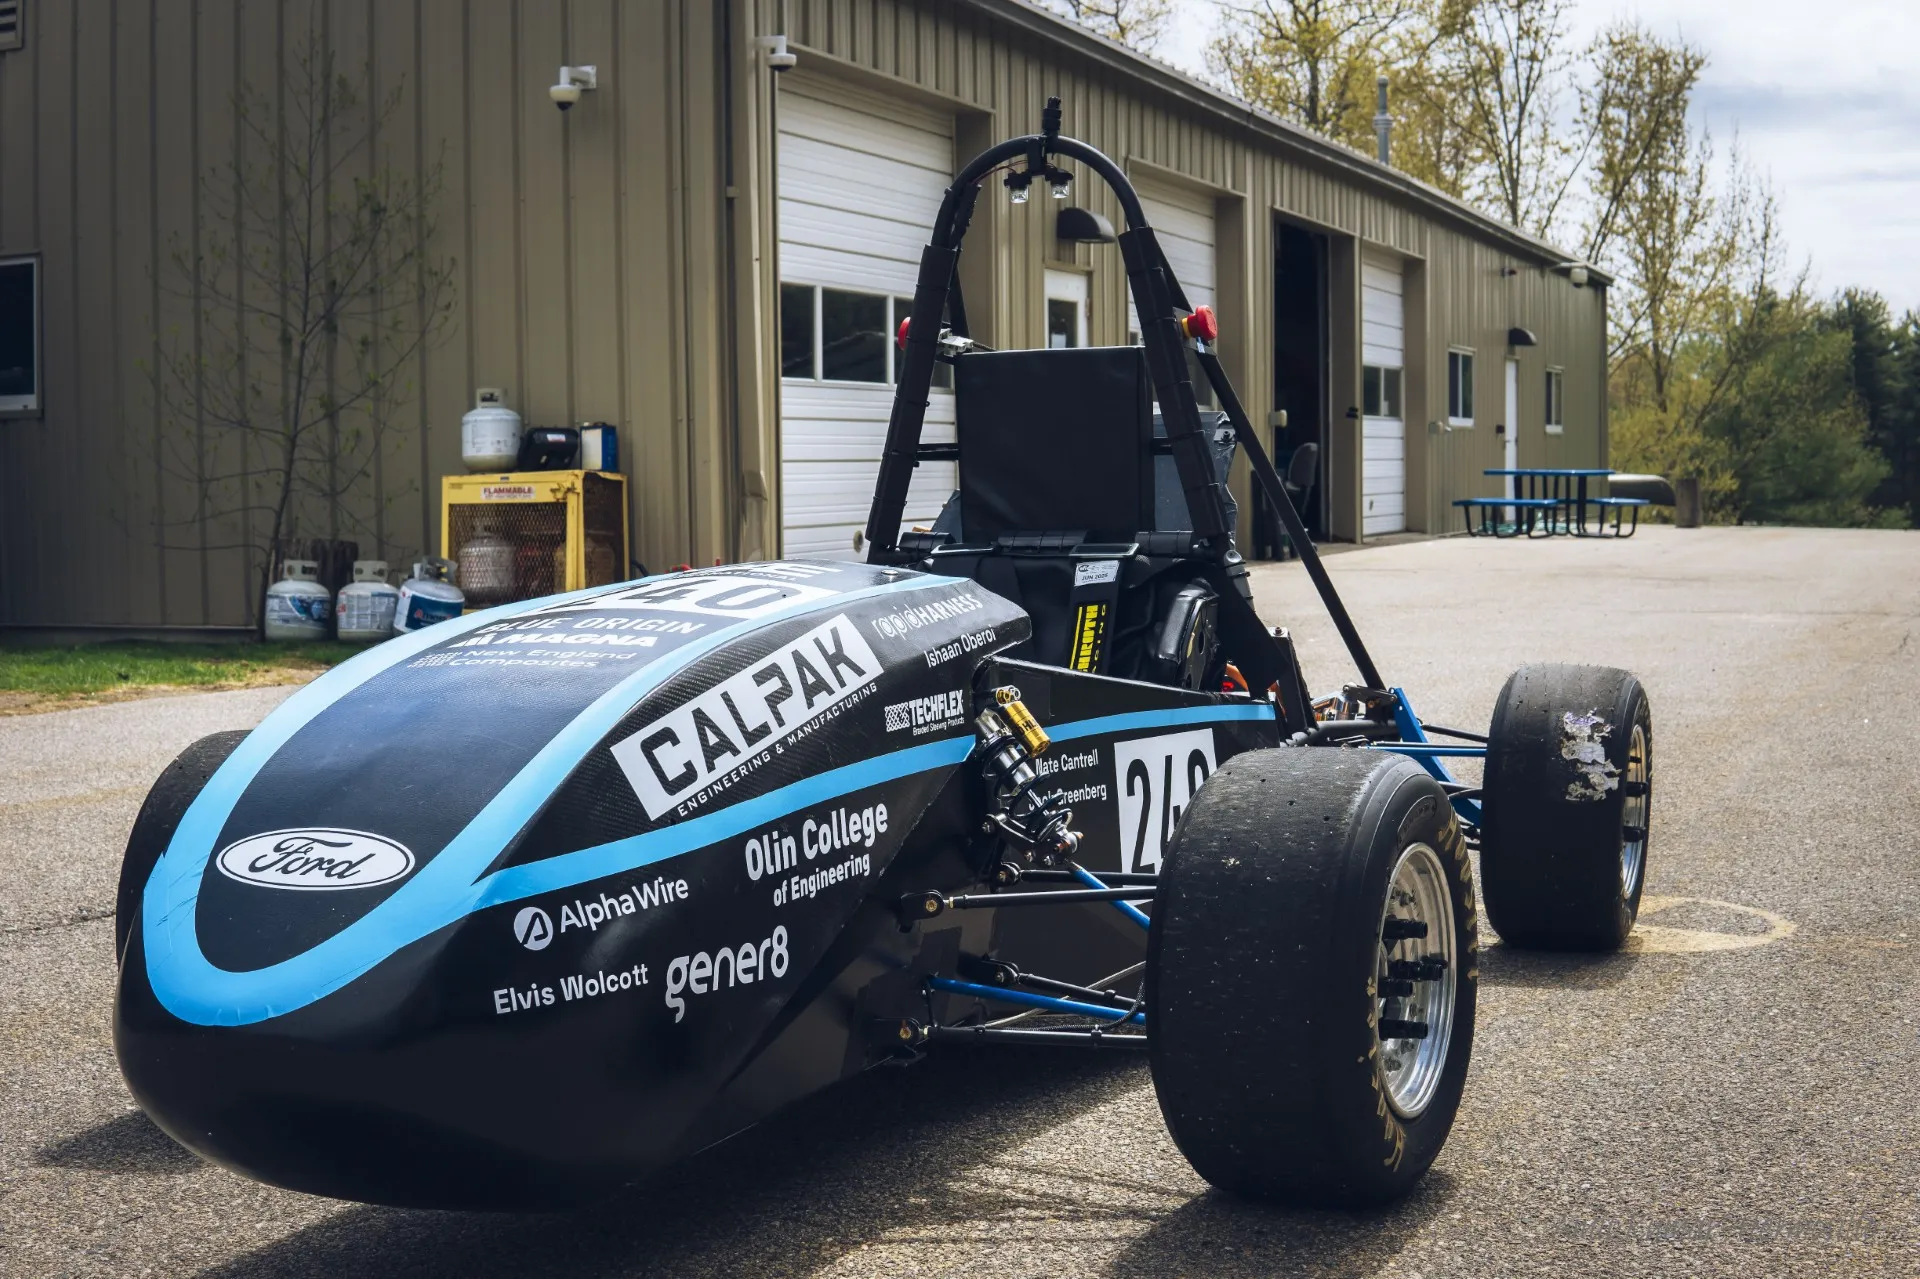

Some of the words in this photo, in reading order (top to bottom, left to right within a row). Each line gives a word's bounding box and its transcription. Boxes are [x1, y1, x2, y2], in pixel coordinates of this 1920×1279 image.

[483, 486, 534, 495] FLAMMABLE
[473, 618, 573, 635] BLUE
[572, 617, 707, 634] ORIGIN
[871, 593, 983, 640] rapidHARNESS
[492, 633, 658, 647] MAGNA
[526, 649, 638, 660] England
[923, 641, 962, 668] Ishaan
[961, 624, 997, 652] Oberoi
[448, 658, 600, 668] Composites
[640, 626, 866, 796] CALPAK
[908, 690, 964, 726] TECHFLEX
[677, 751, 771, 817] ENGINEERING
[775, 744, 785, 754] &
[787, 682, 877, 746] MANUFACTURING
[1035, 757, 1059, 775] Nate
[1061, 748, 1098, 771] Cantrell
[248, 836, 376, 879] Ford
[745, 831, 797, 881] Olin
[802, 803, 888, 860] College
[773, 879, 788, 907] of
[791, 853, 870, 900] Engineering
[493, 983, 556, 1014] Elvis
[560, 963, 649, 1001] Wolcott
[665, 925, 789, 1023] gener8
